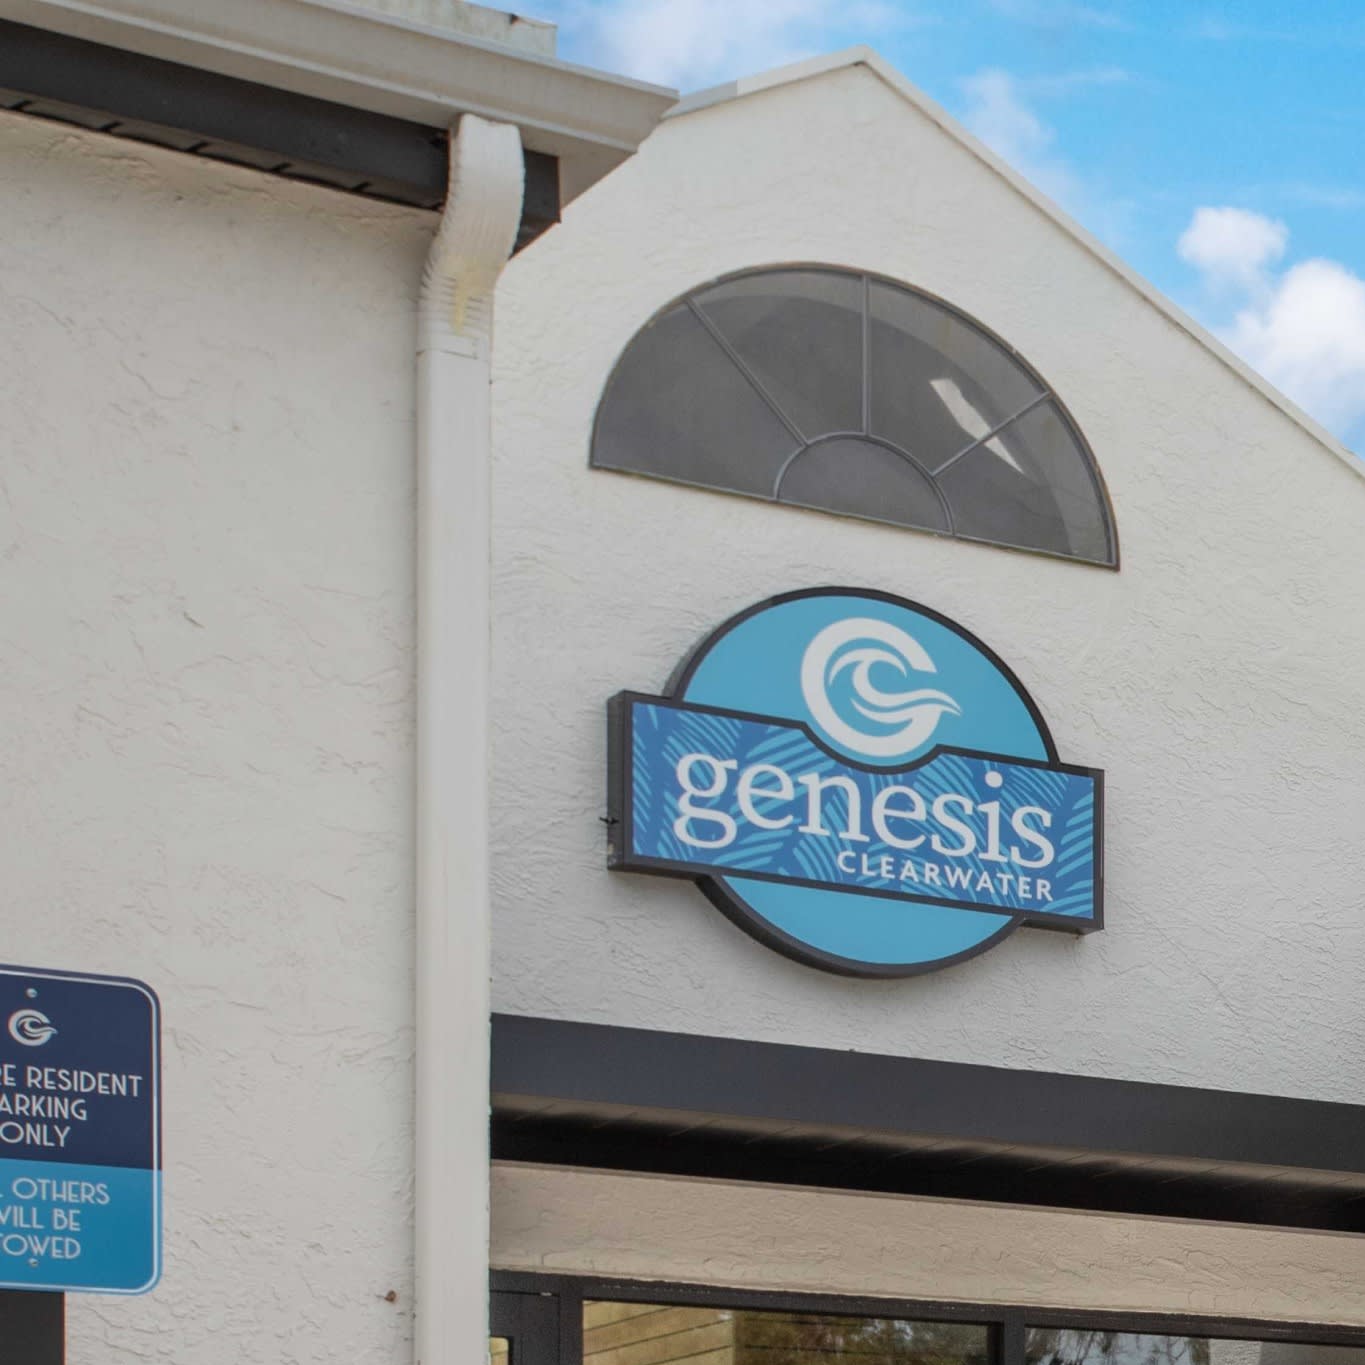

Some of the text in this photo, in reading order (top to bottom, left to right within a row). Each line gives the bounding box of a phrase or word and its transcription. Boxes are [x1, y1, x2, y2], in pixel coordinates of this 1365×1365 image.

[673, 753, 1056, 869] genesis
[836, 851, 1054, 902] CLEARWATER
[26, 1065, 143, 1098] RESIDENT
[0, 1093, 87, 1121] ARKING
[0, 1121, 71, 1148] ONLY
[12, 1177, 110, 1206] OTHERS
[52, 1207, 81, 1232] BE
[0, 1232, 81, 1259] OWED
